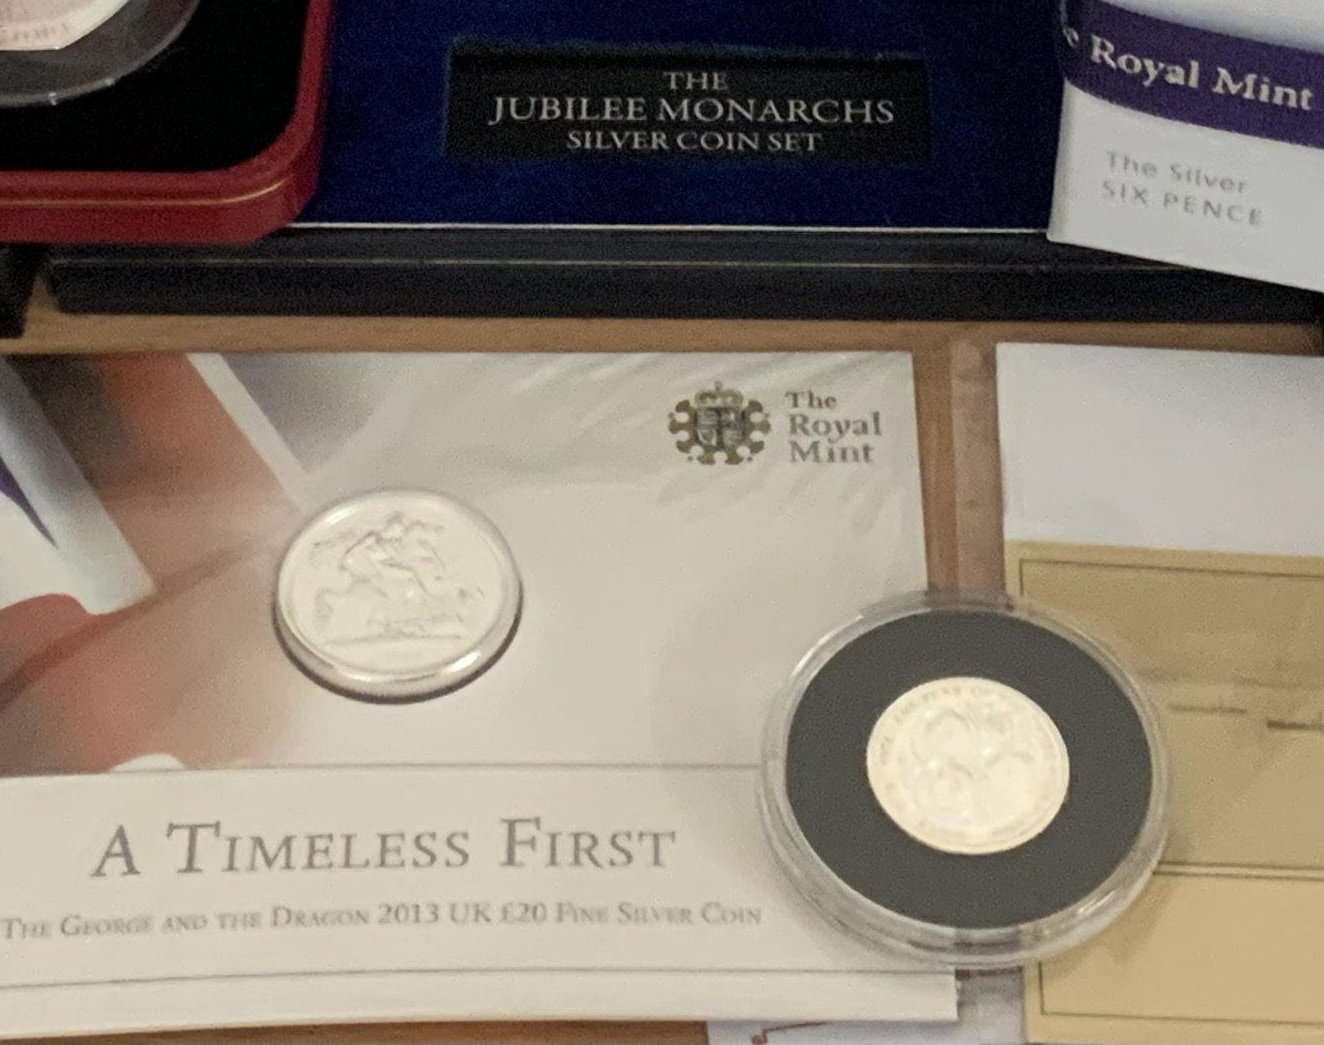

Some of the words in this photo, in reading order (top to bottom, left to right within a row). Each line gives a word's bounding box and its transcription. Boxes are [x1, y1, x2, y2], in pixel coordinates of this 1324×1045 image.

[663, 70, 729, 92] THE
[1089, 33, 1201, 91] Royal
[1211, 66, 1314, 112] Mint
[488, 96, 647, 126] JUBILEE
[658, 97, 895, 125] MONARCHS
[566, 130, 670, 152] SILVER
[676, 130, 760, 152] COIN
[767, 132, 823, 154] SET
[1103, 150, 1157, 180] The
[1168, 161, 1250, 195] Silver
[1099, 177, 1148, 208] SIX
[1161, 189, 1266, 229] PENCE
[784, 390, 838, 411] The
[787, 410, 883, 444] Royal
[787, 440, 876, 465] Mint
[88, 823, 142, 879] A
[165, 819, 471, 875] TIMELESS
[497, 815, 677, 870] FIRST
[0, 917, 52, 942] THE
[59, 913, 155, 939] GEORGE
[161, 914, 209, 934] AND
[216, 911, 262, 931] THE
[269, 905, 371, 929] DRAGON
[377, 902, 440, 926] 2013
[448, 902, 492, 925] UK
[498, 901, 549, 925] £20
[555, 902, 610, 924] FINE
[616, 902, 694, 925] SILVER
[699, 902, 763, 925] COIN
